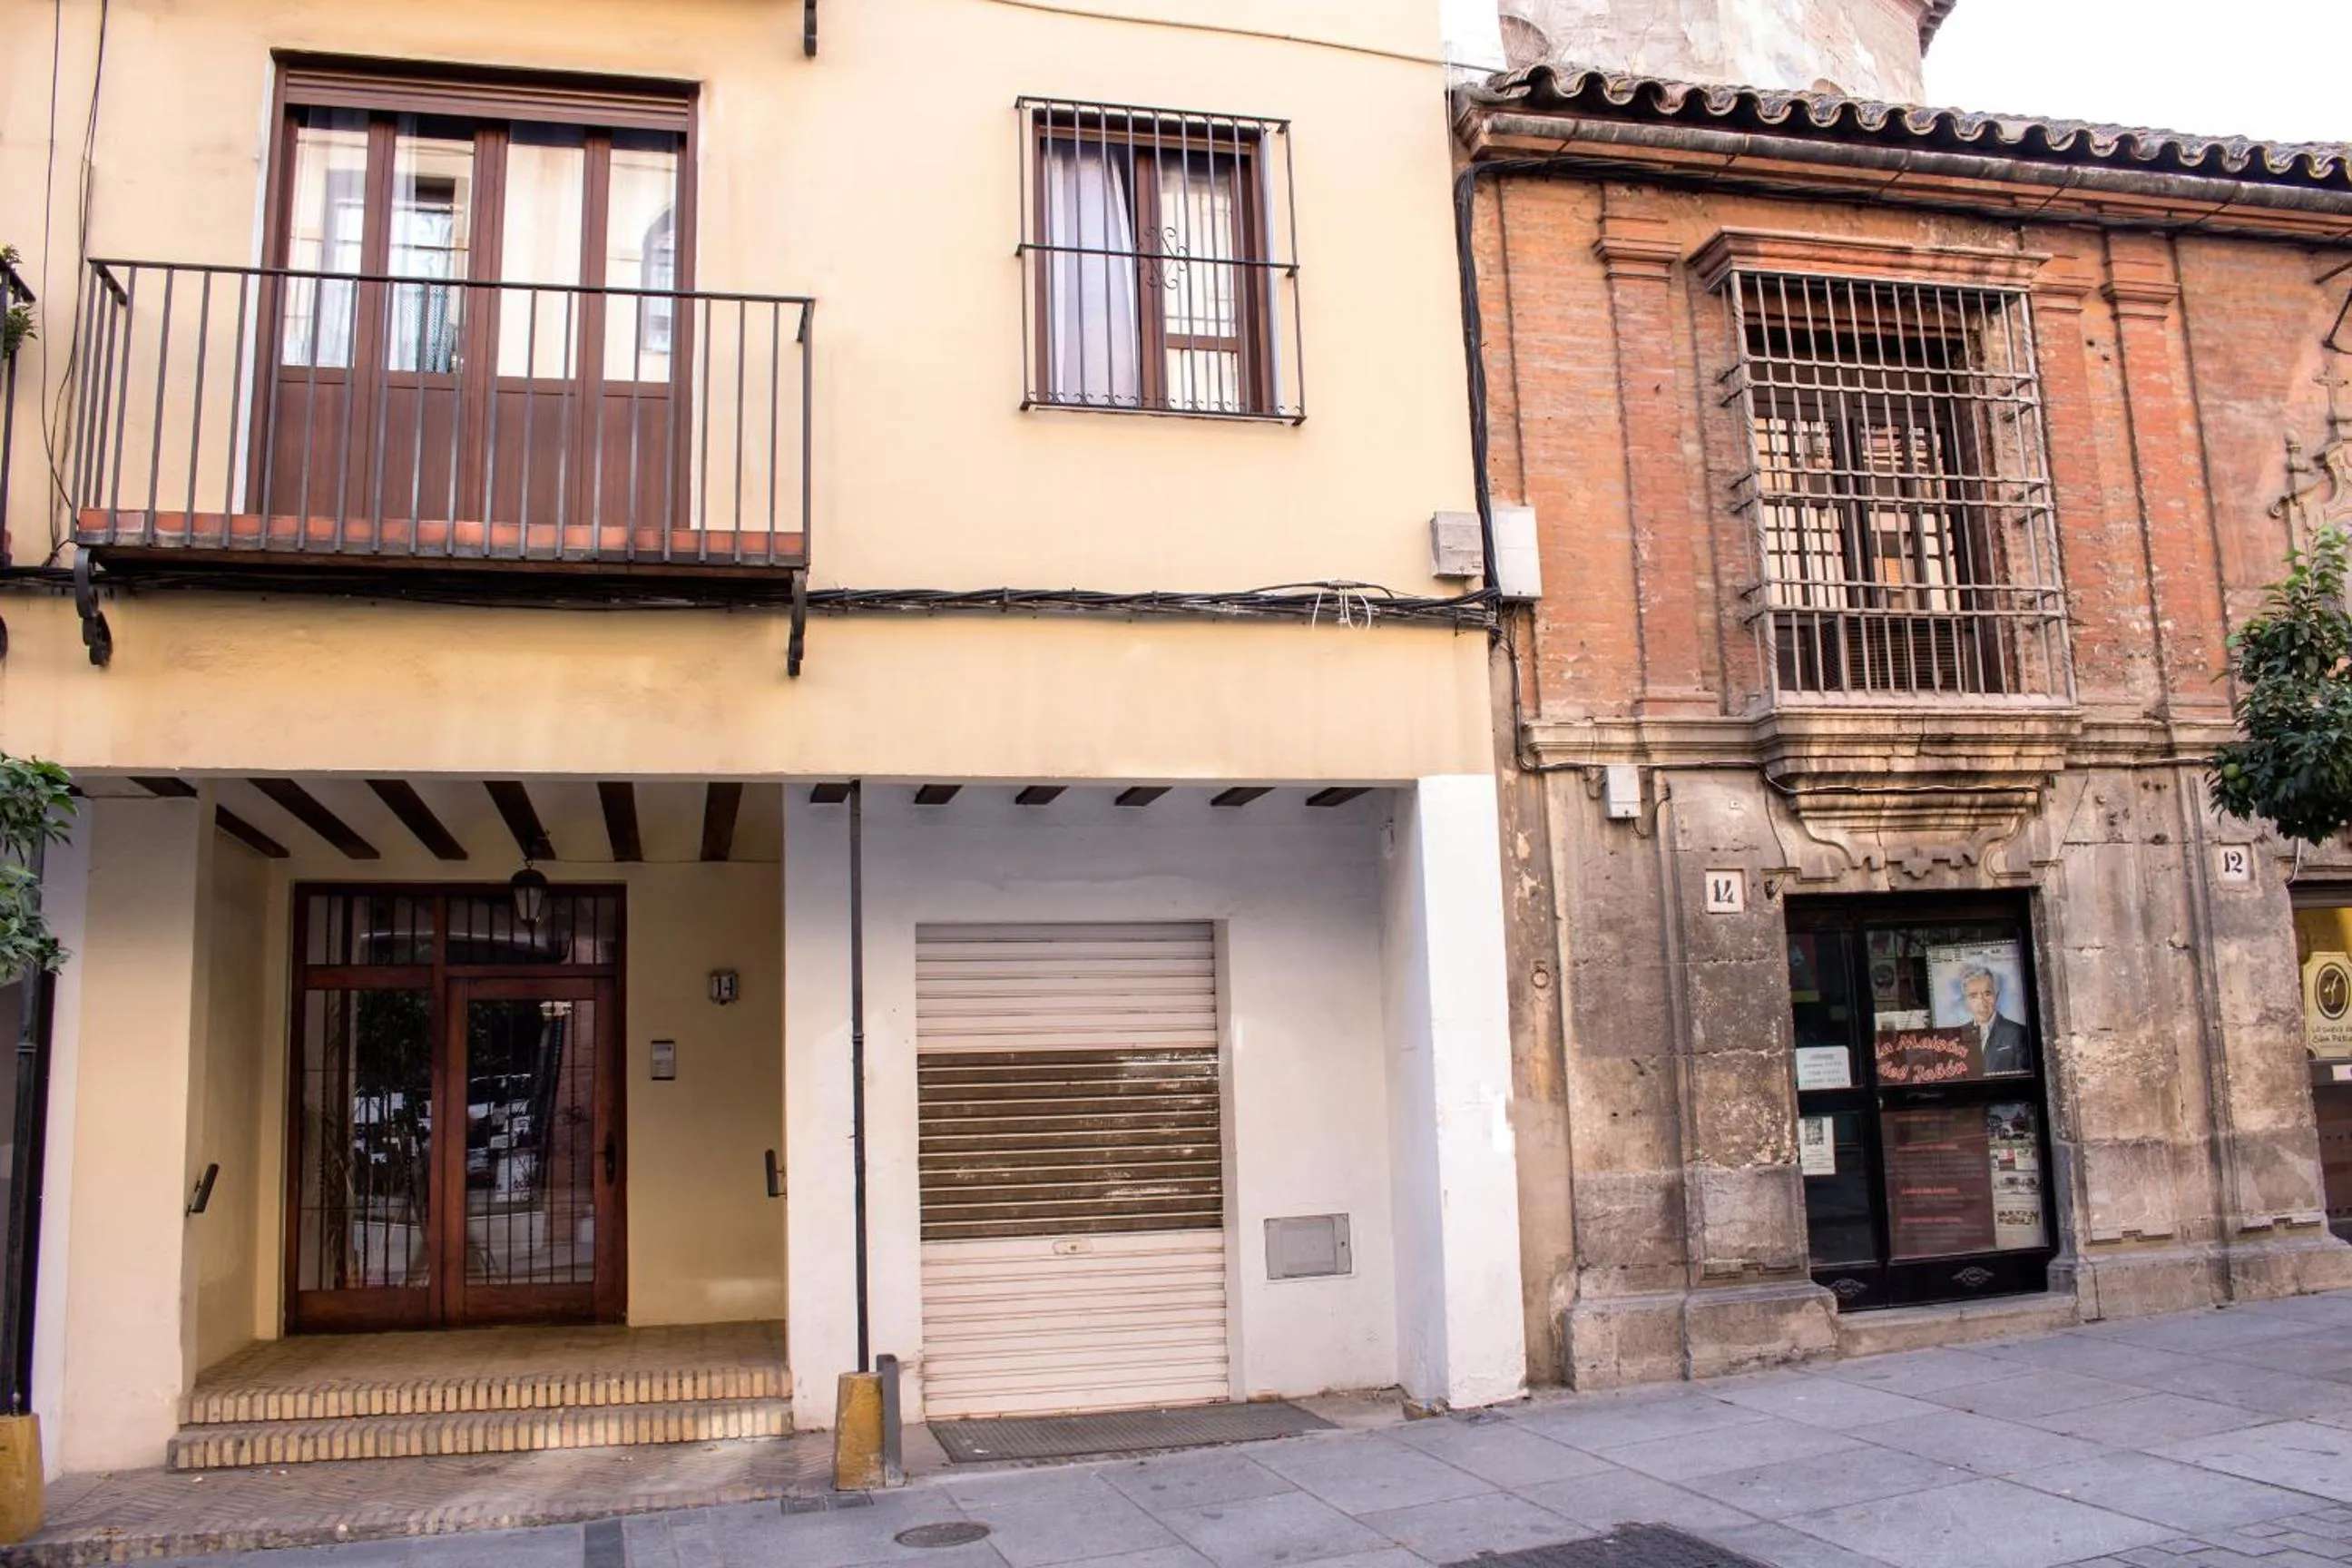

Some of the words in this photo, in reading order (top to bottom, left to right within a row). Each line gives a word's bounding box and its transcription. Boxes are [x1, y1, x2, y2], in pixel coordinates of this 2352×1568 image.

[2224, 851, 2243, 873] 12
[1714, 879, 1735, 904] 14
[718, 976, 733, 996] 14
